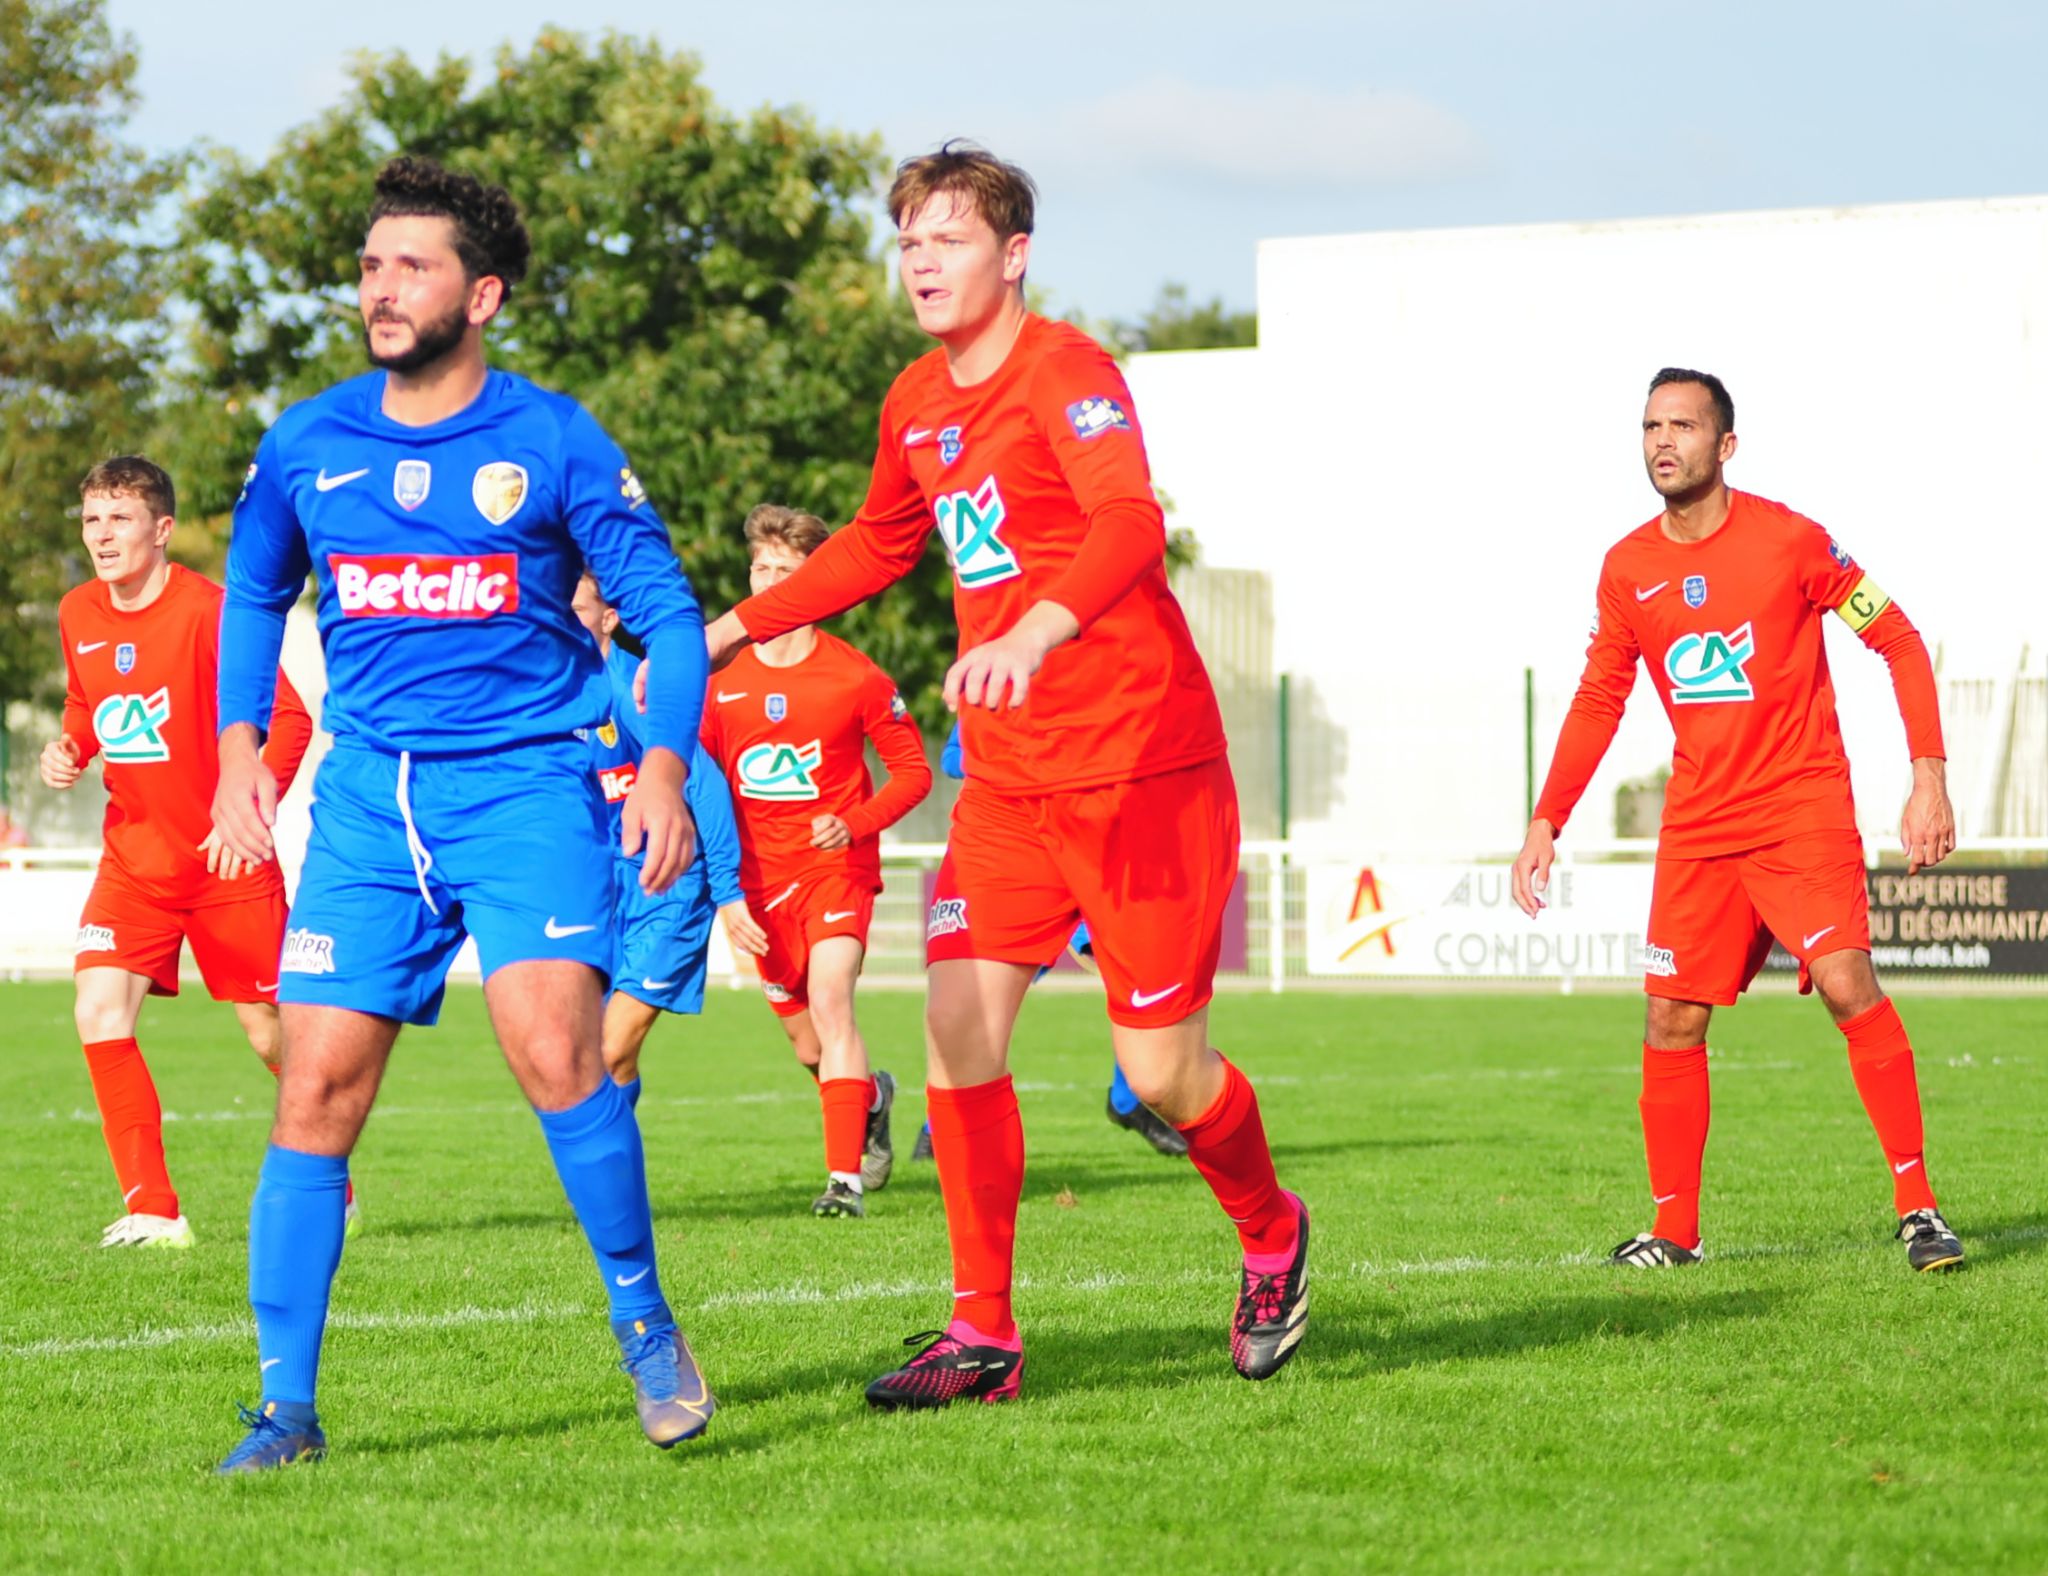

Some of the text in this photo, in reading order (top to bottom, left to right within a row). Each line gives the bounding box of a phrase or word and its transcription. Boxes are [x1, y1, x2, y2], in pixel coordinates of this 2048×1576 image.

[338, 562, 508, 611] Betclic
[1850, 592, 1874, 618] C
[601, 772, 635, 798] lic
[1441, 871, 1573, 908] AUE
[1434, 932, 1645, 969] CONDUITE
